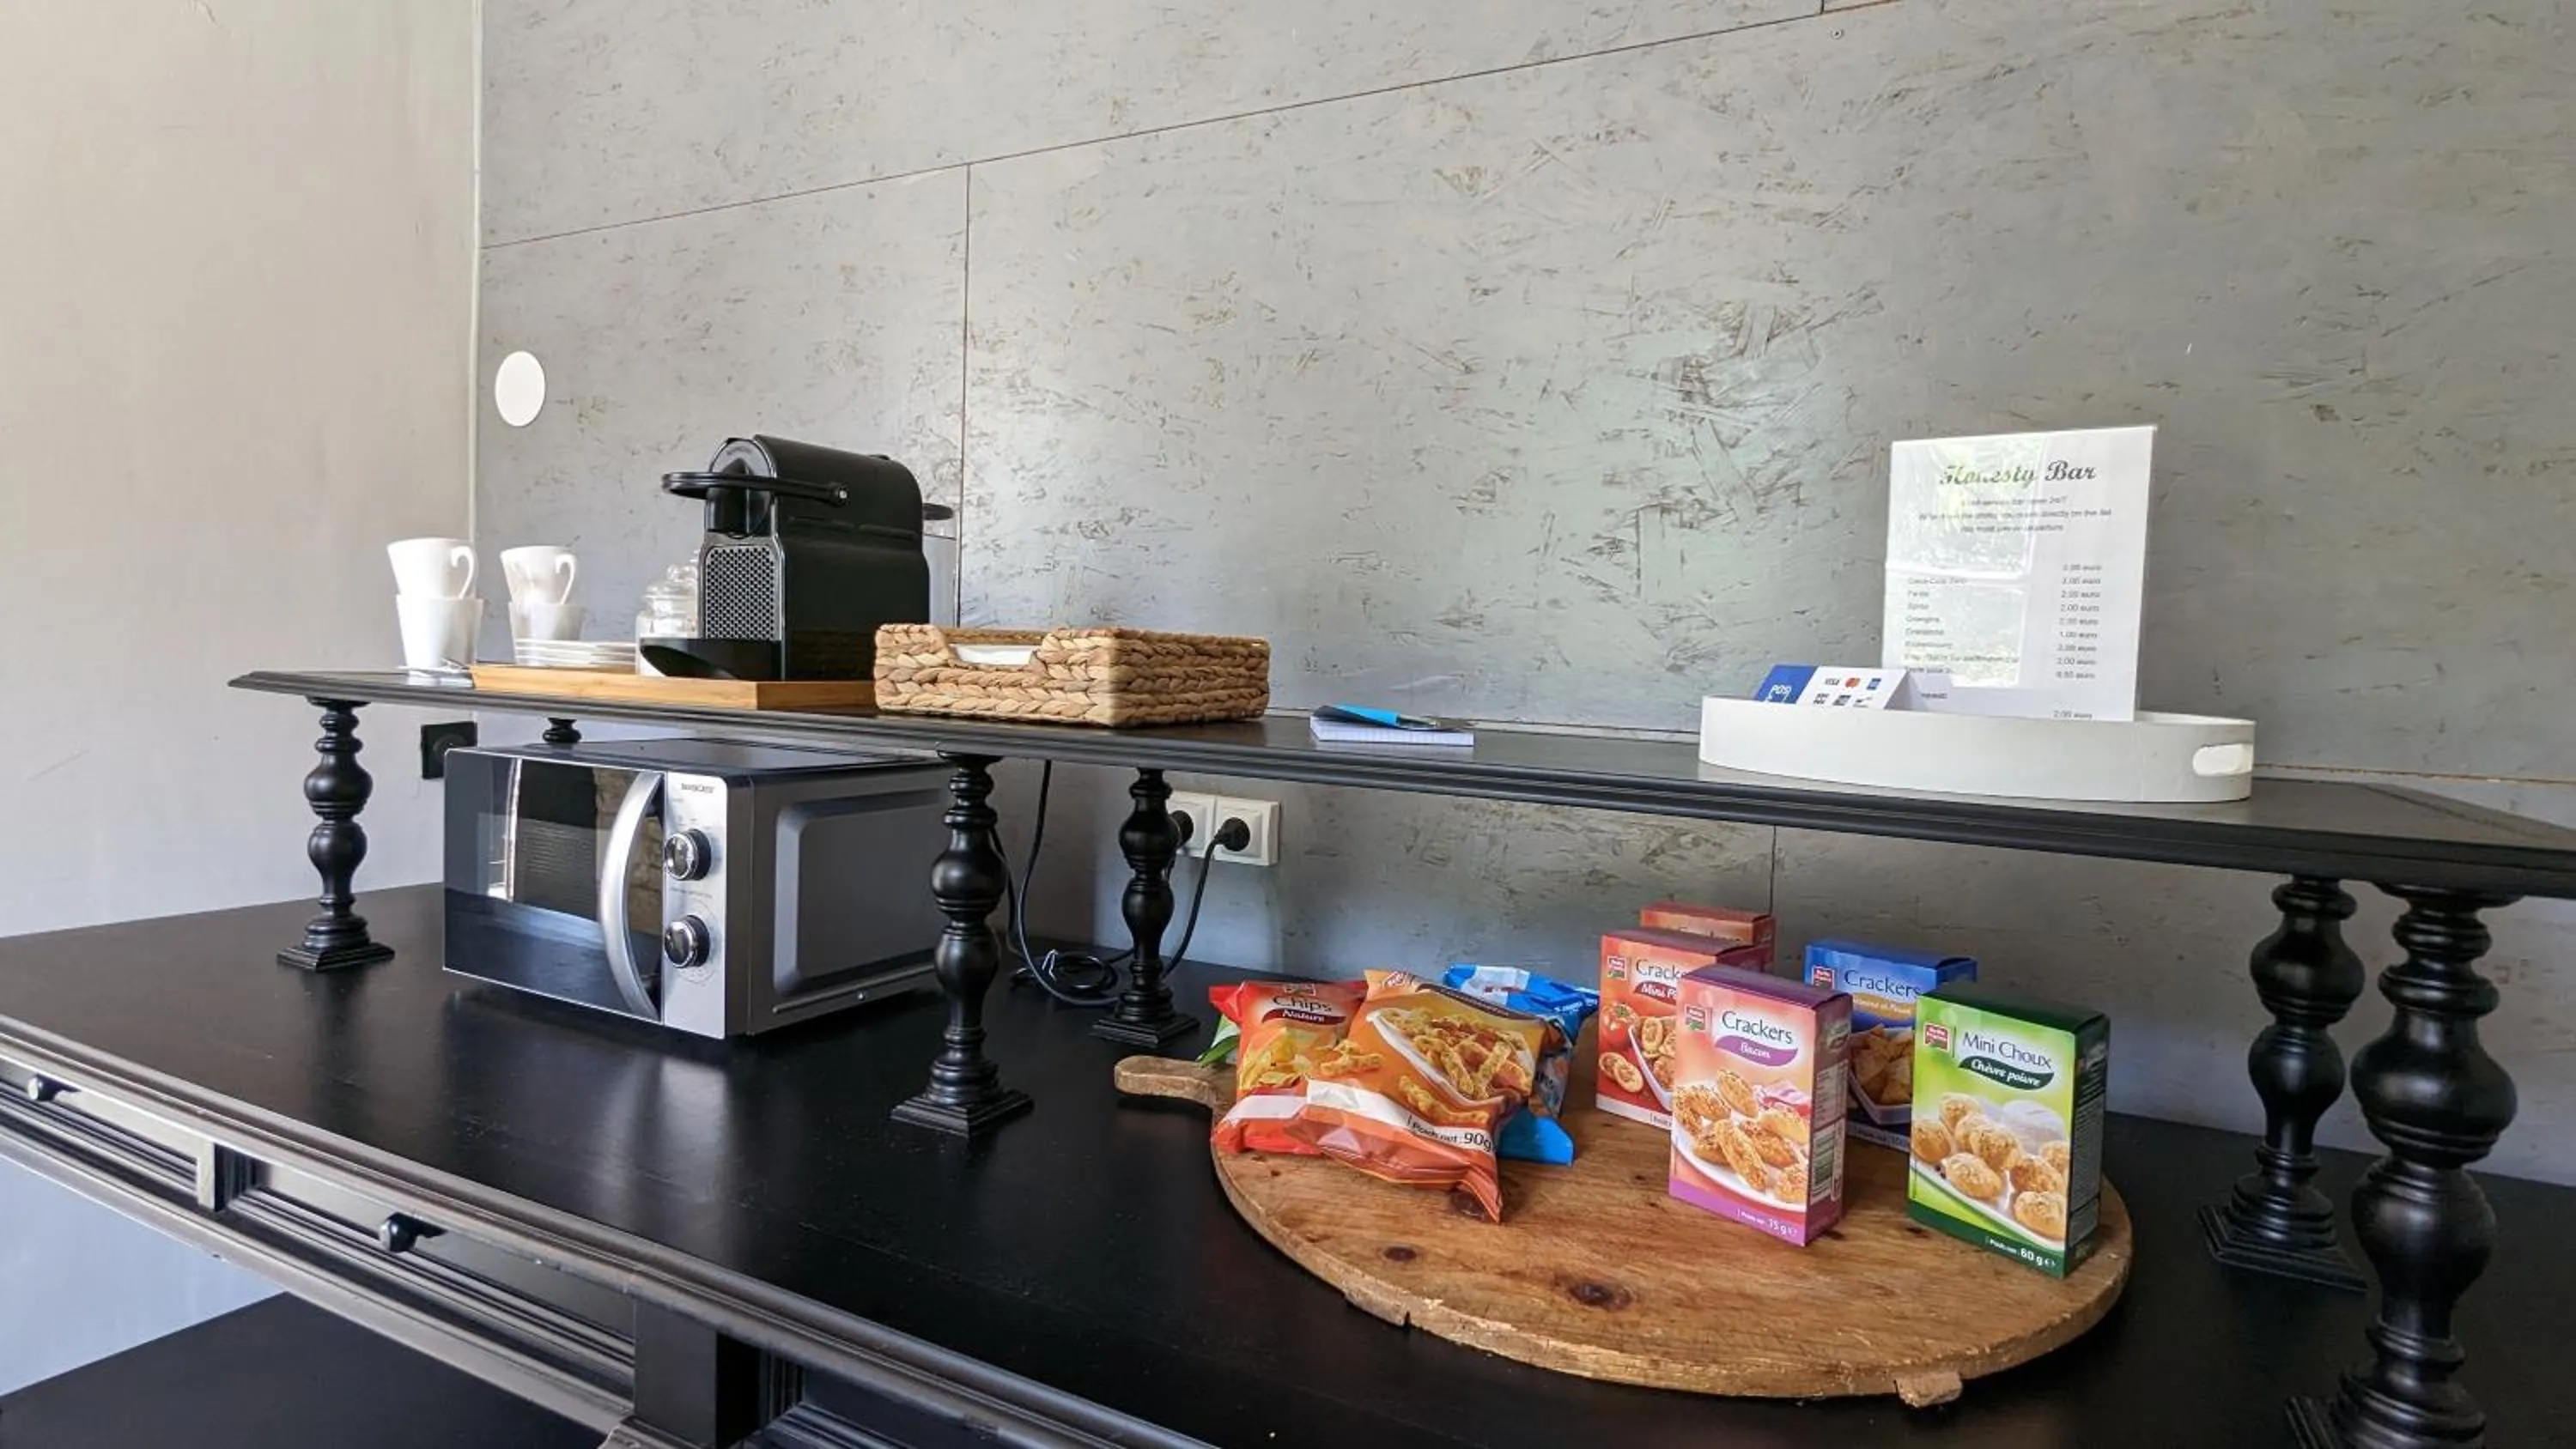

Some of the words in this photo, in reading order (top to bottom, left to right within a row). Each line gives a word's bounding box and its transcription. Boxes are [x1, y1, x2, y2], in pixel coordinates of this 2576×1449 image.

[1939, 464, 2035, 489] Honesty
[2044, 460, 2097, 482] Bar
[1844, 969, 1922, 997] Crackers
[1273, 995, 1334, 1013] Chips
[1282, 1009, 1325, 1023] Nature
[1722, 1009, 1794, 1045] Crackers
[1741, 1041, 1771, 1058] Bacon
[1963, 1031, 1995, 1054] Mini
[1998, 1041, 2052, 1070] Choux
[1971, 1058, 2007, 1078] Chèvre
[1463, 1131, 1492, 1152] 90g
